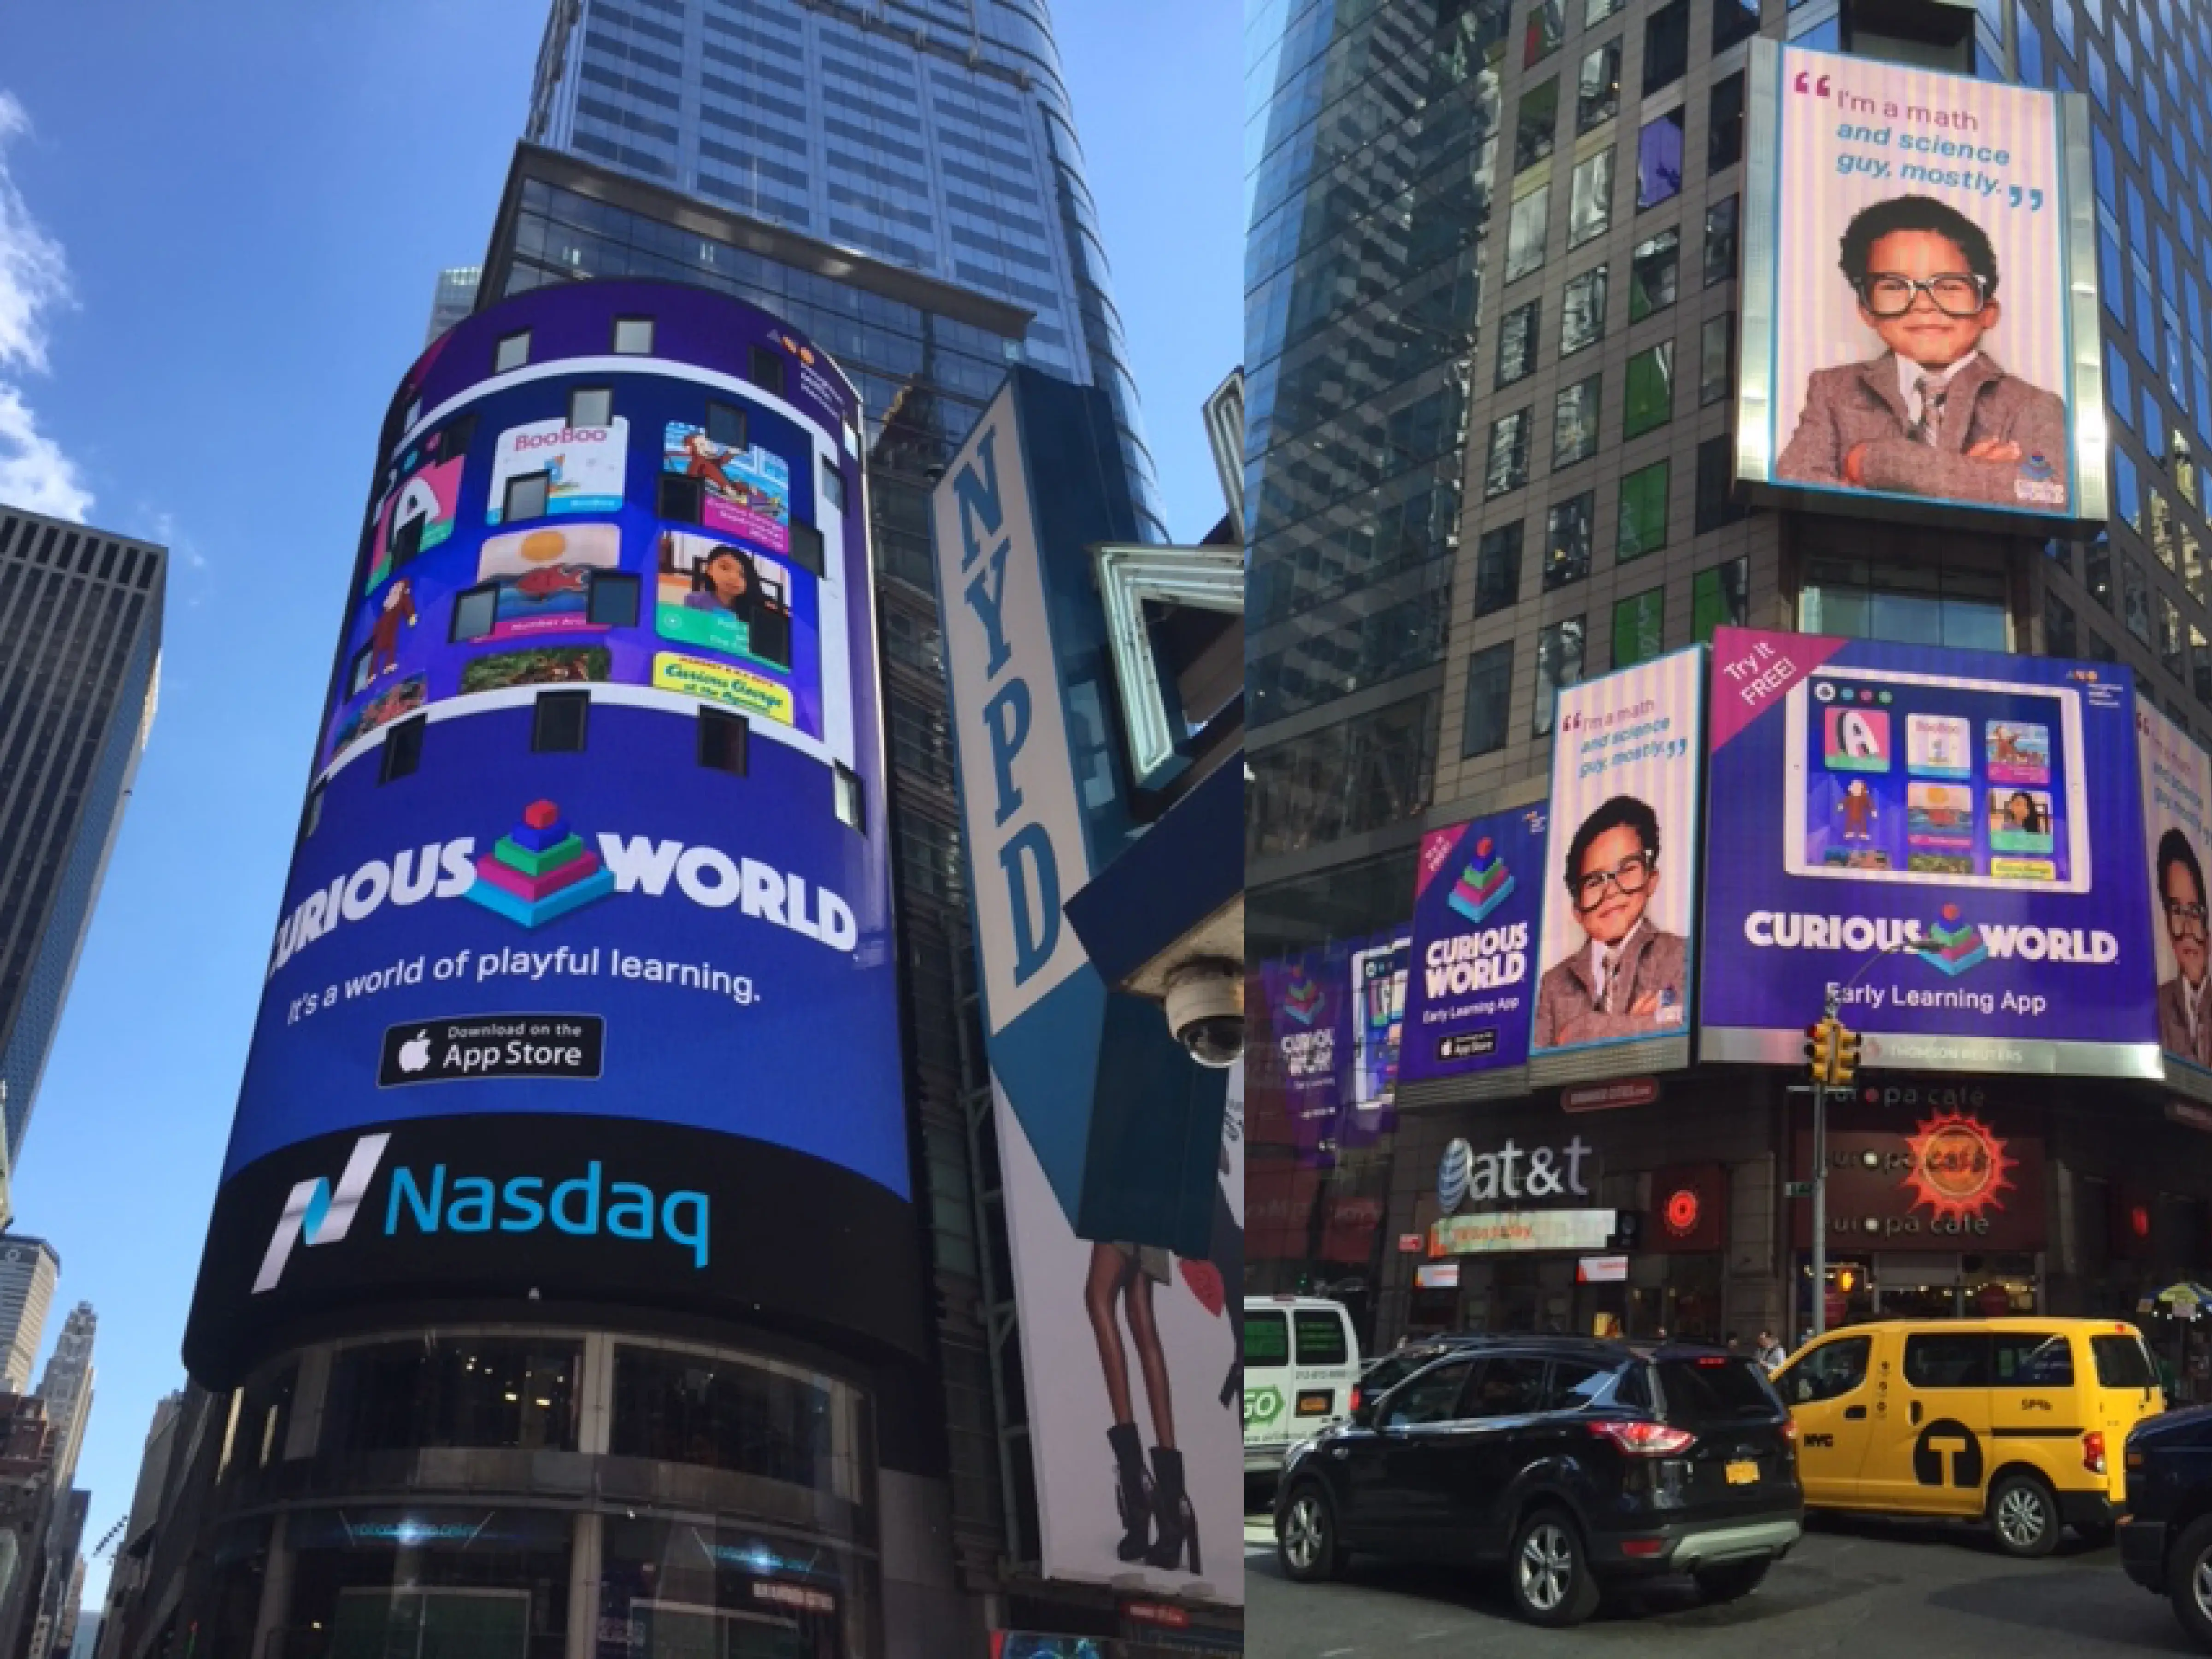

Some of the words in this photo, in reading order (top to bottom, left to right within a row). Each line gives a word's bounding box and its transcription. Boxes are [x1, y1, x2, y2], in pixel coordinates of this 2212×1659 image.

[1883, 103, 1899, 118] a
[1906, 104, 1979, 131] math
[1836, 123, 1891, 146] and
[1898, 132, 2011, 166] science
[1835, 152, 1892, 178] guy,
[1723, 653, 1759, 681] Try
[953, 425, 1061, 988] NYPD
[1617, 700, 1654, 721] math
[1581, 734, 1610, 753] and
[1612, 717, 1670, 744] science
[268, 837, 477, 978] URIOUS
[598, 832, 858, 955] WORLD
[1426, 922, 1528, 967] CURIOUS
[1745, 910, 1922, 954] CURIOUS
[1978, 924, 2118, 964] WORLD
[322, 985, 337, 1008] a
[344, 954, 425, 999] world
[433, 949, 472, 980] of
[477, 946, 599, 982] playful
[611, 948, 760, 1006] learning.
[1425, 951, 1526, 999] WORLD
[1423, 1008, 1447, 1024] Early
[1451, 1001, 1494, 1019] Learning
[1498, 996, 1519, 1011] App
[1825, 982, 1884, 1008] Early
[1892, 986, 1994, 1012] Learning
[2001, 991, 2047, 1015] App
[447, 1024, 525, 1039] Download
[529, 1025, 550, 1035] on
[556, 1024, 582, 1036] the
[443, 1044, 500, 1073] App
[505, 1040, 582, 1066] Store
[1470, 1135, 1592, 1200] at&t
[385, 1161, 708, 1268] Nasdaq
[1804, 1433, 1833, 1448] NYC
